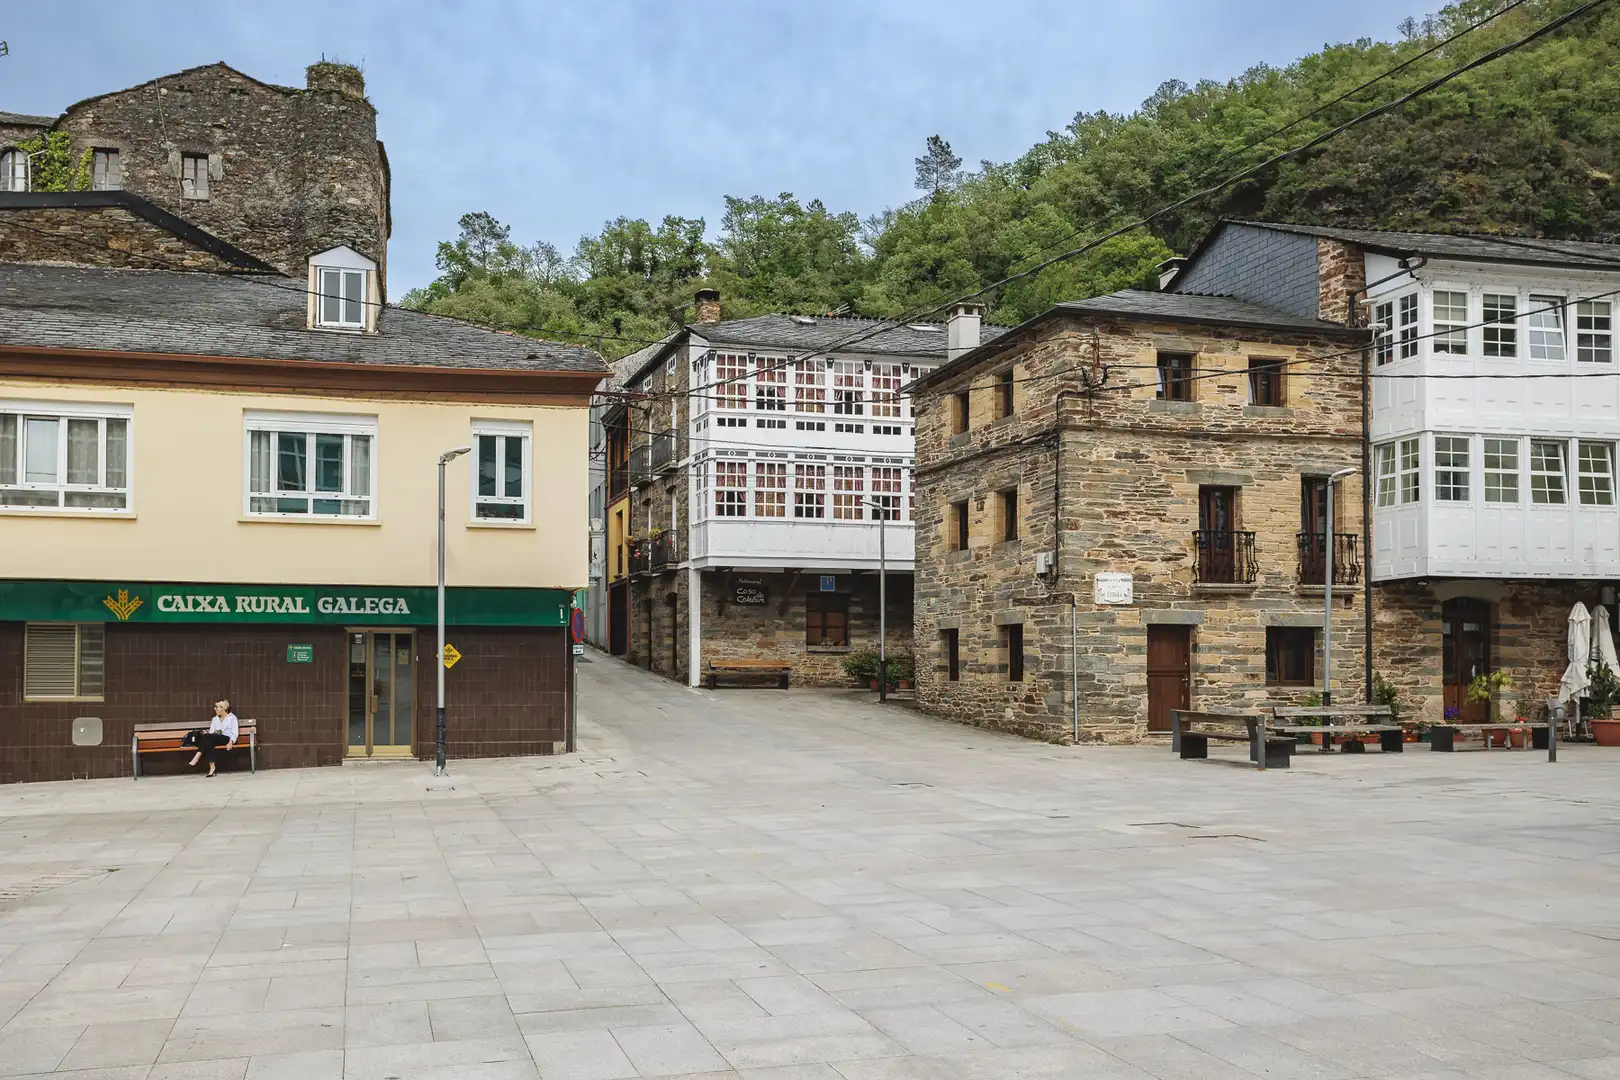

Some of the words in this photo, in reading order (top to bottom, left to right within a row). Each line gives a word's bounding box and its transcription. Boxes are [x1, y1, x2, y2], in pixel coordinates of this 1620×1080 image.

[157, 595, 231, 612] CAIXA
[236, 596, 310, 613] RURAL
[317, 597, 411, 614] GALEGA
